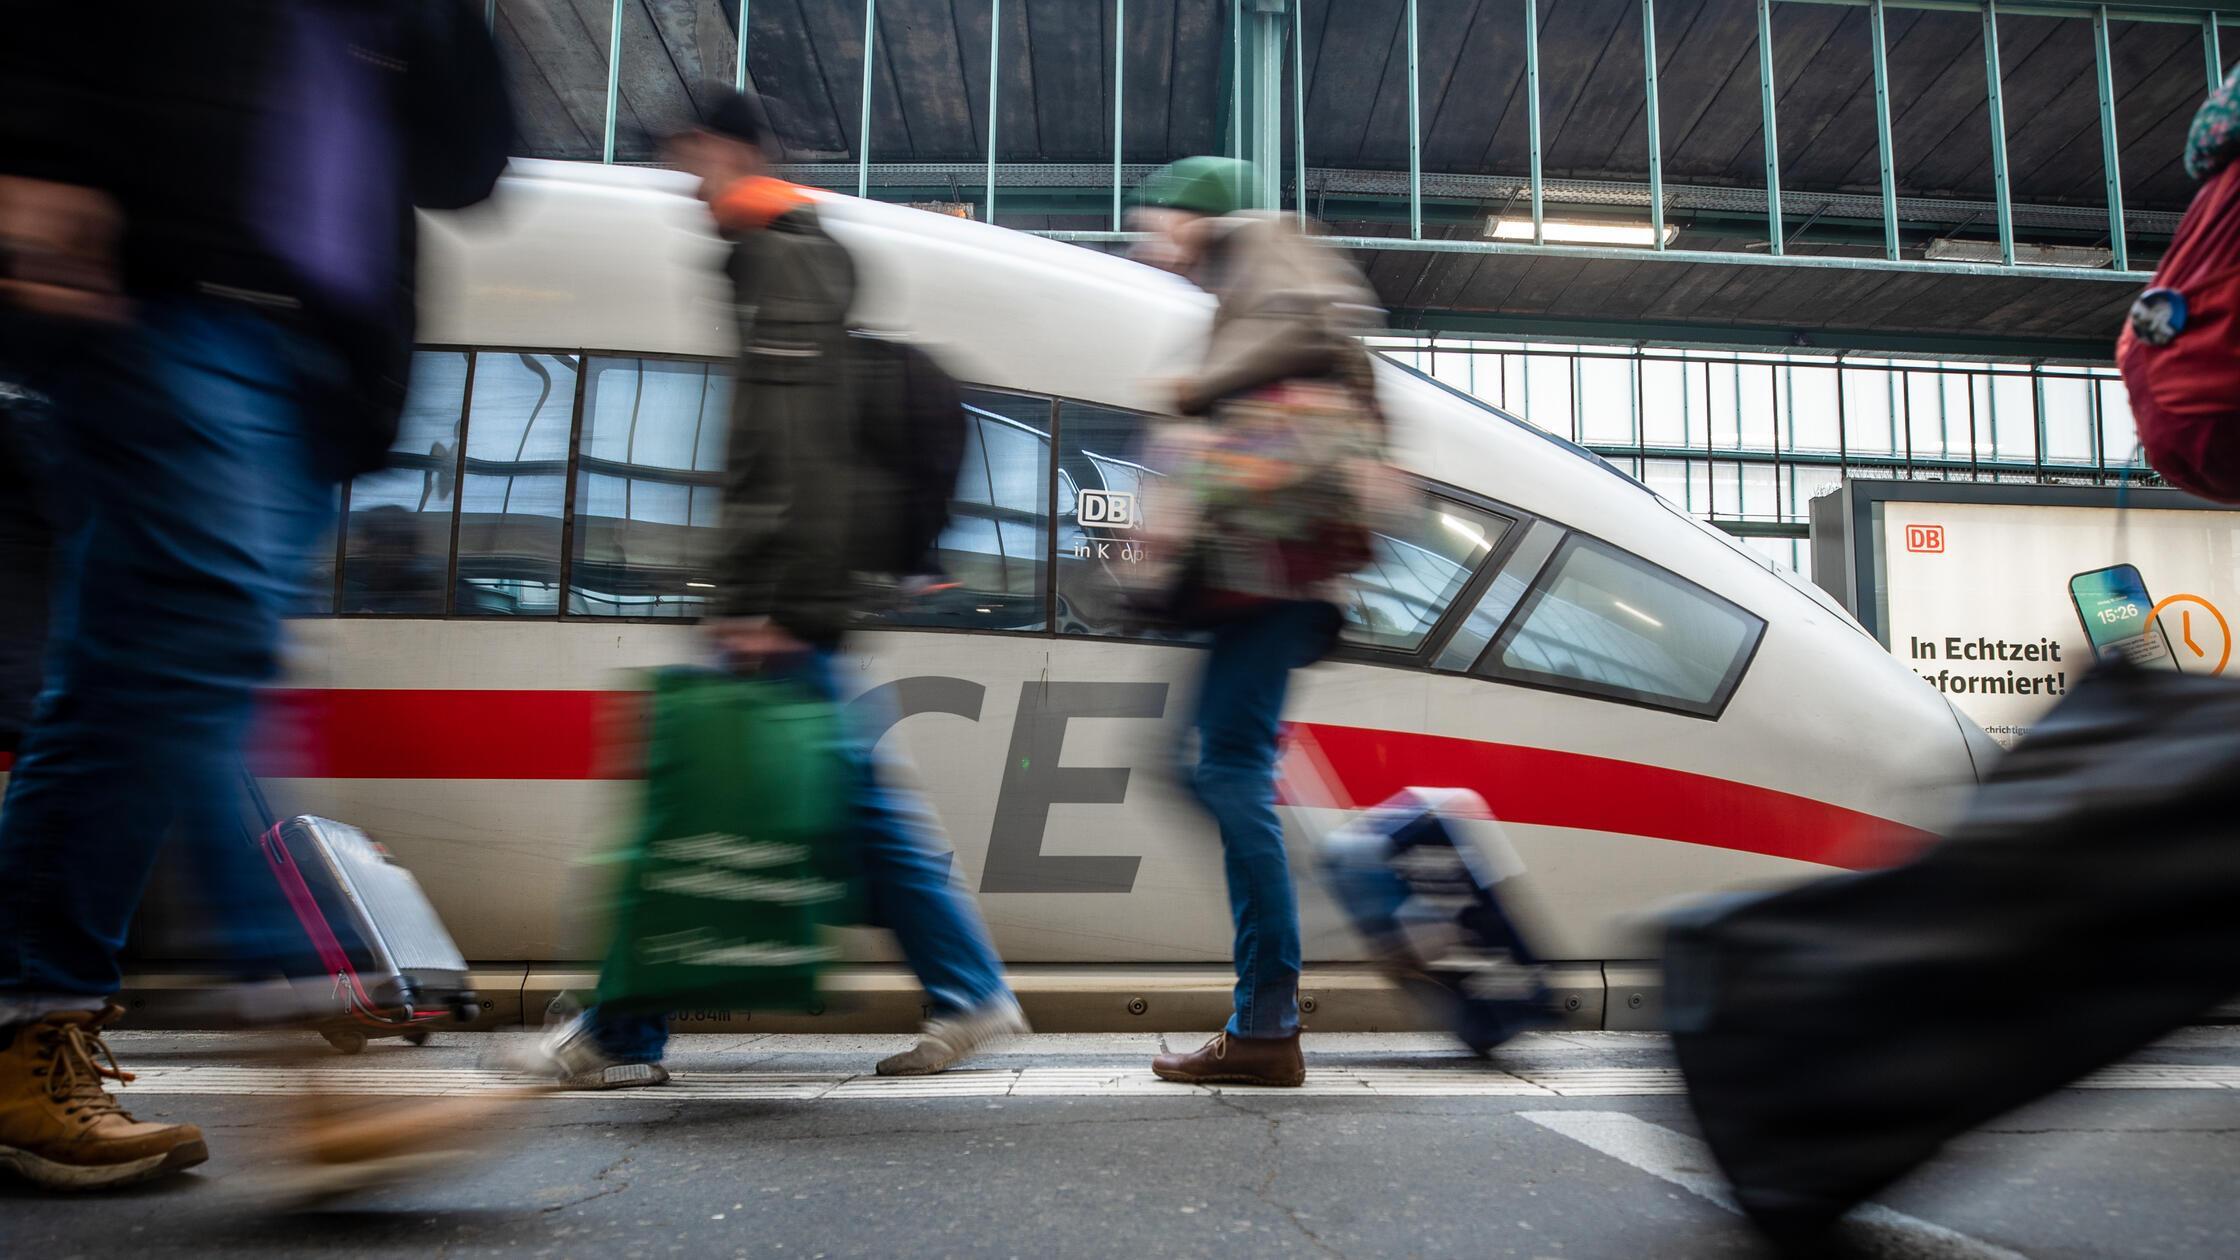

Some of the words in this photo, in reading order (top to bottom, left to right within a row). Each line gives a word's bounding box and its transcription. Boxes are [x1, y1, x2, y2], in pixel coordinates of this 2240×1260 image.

[1084, 494, 1128, 523] DB
[1074, 542, 1090, 558] in
[1910, 528, 1940, 549] DB
[2097, 603, 2138, 625] 15:26
[1911, 636, 1936, 659] In
[1945, 637, 2061, 662] Echtzeit
[1912, 669, 2066, 696] nformiert!
